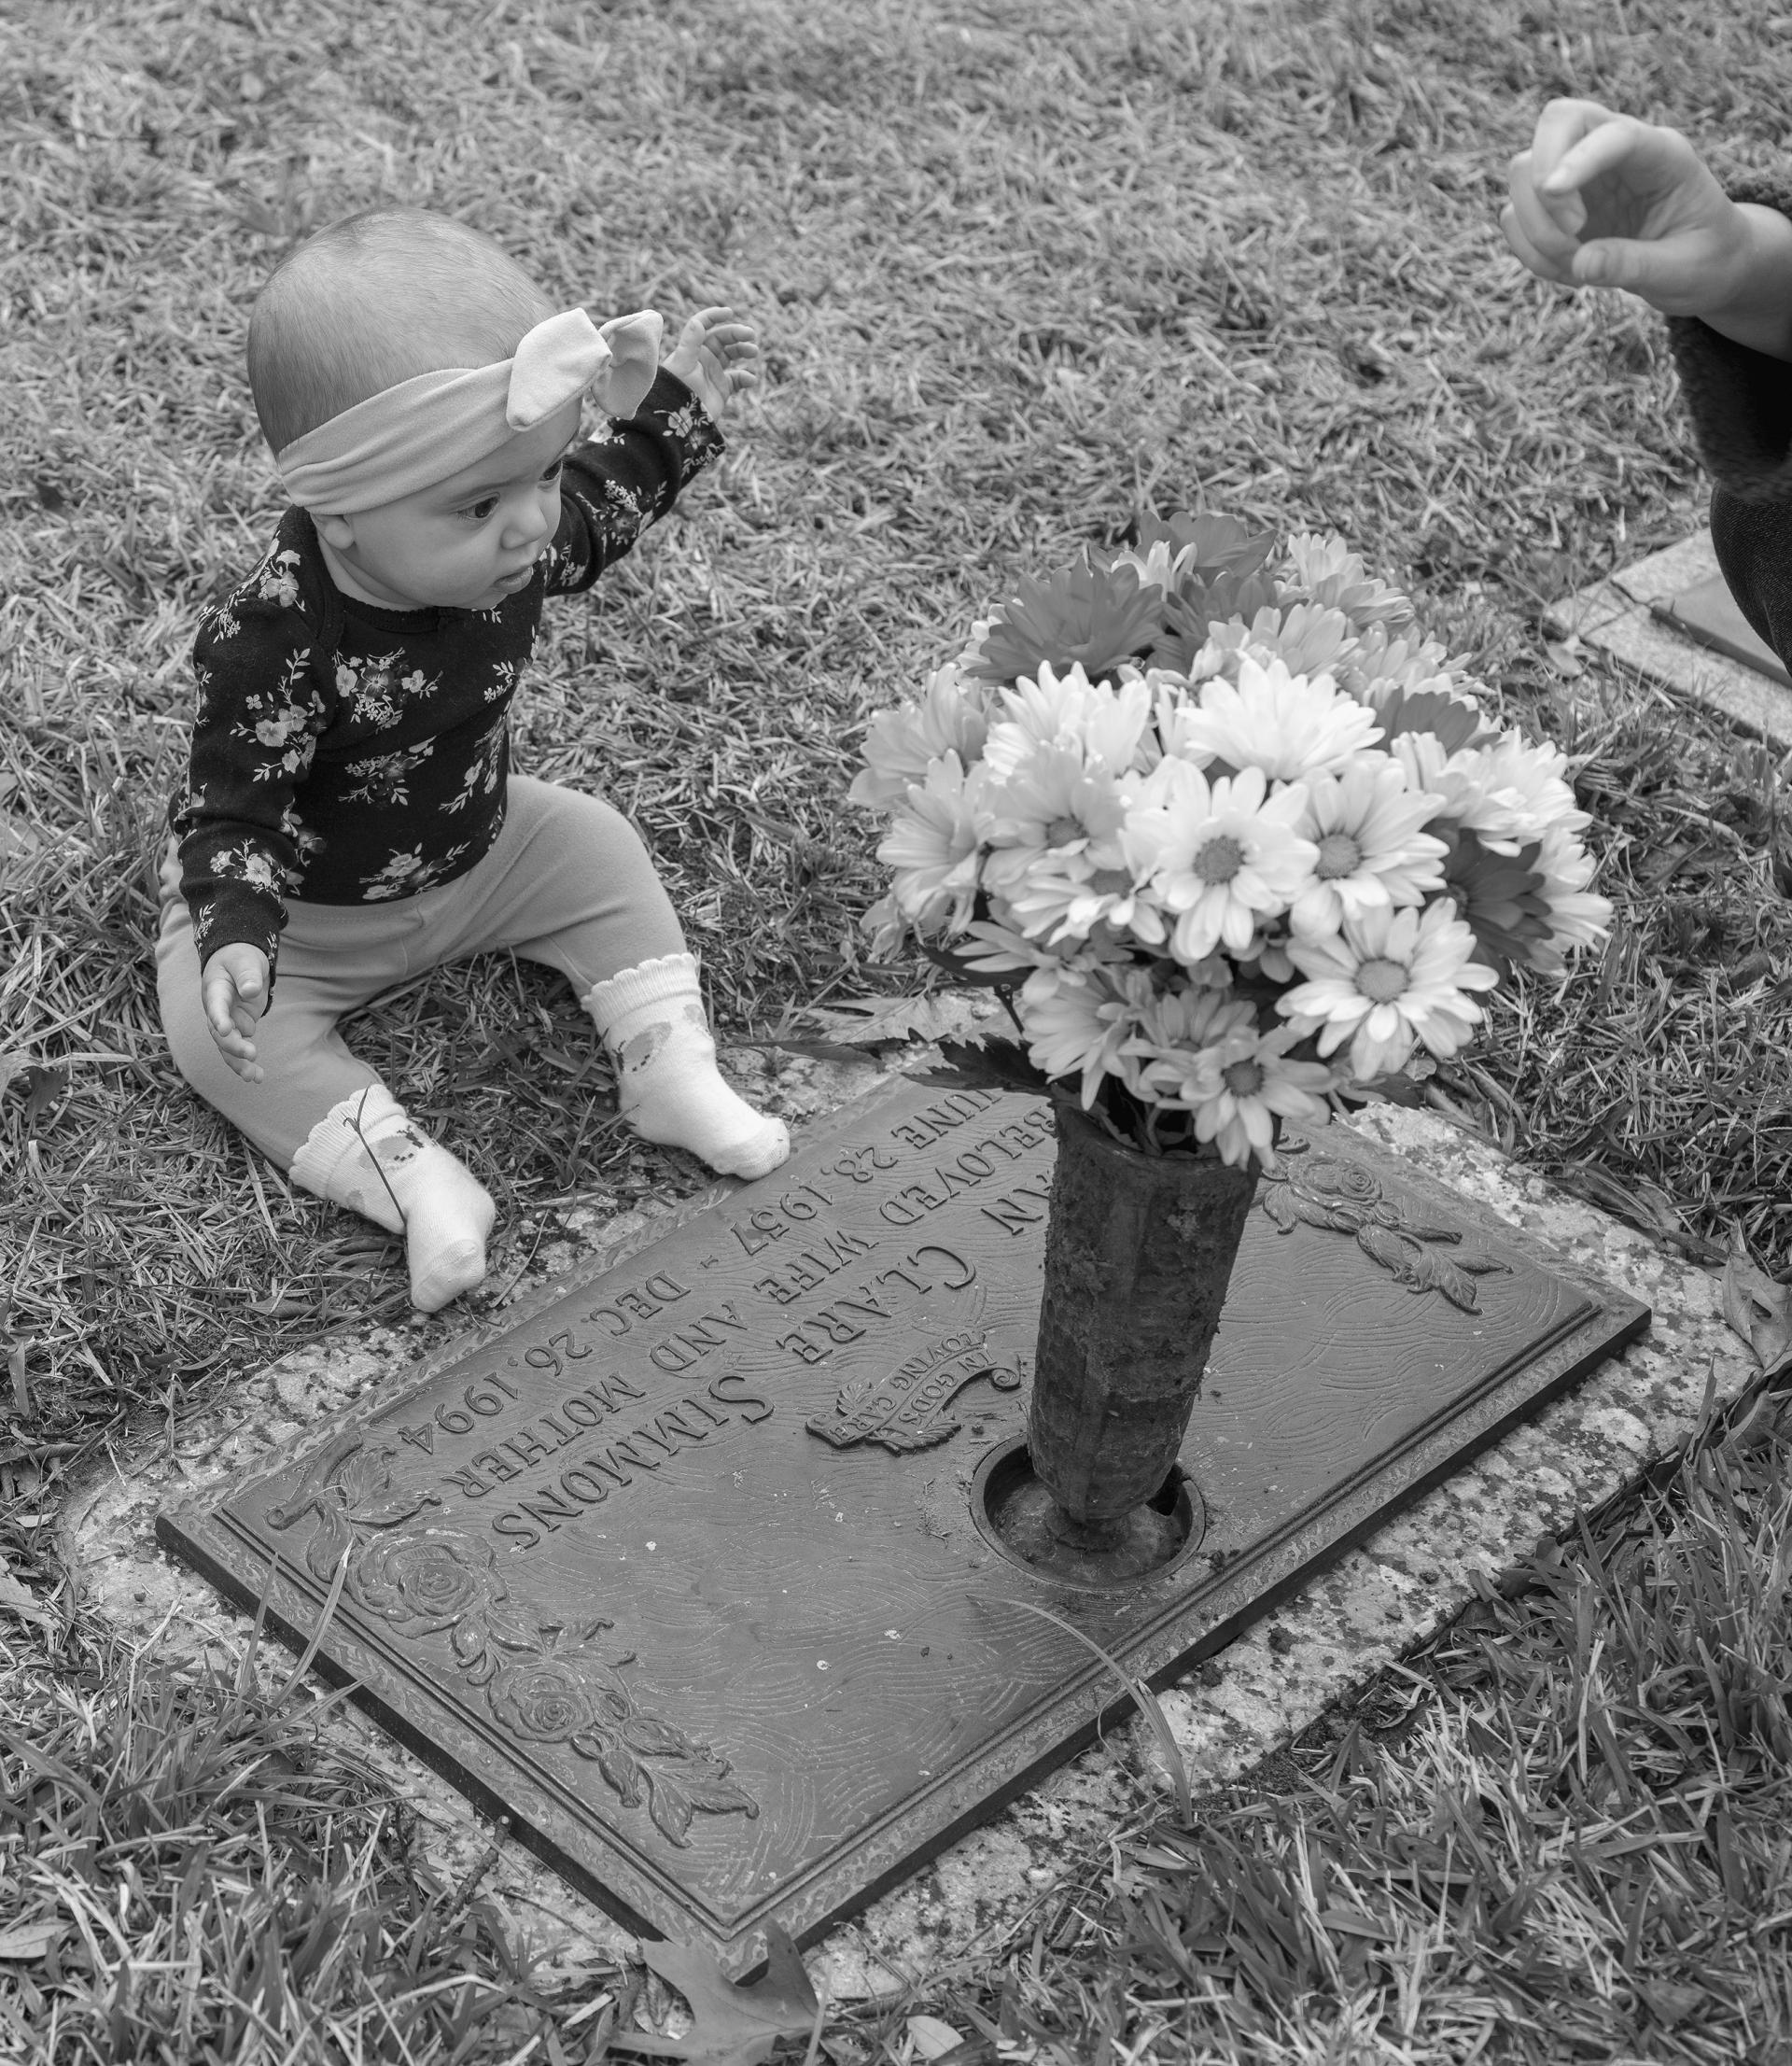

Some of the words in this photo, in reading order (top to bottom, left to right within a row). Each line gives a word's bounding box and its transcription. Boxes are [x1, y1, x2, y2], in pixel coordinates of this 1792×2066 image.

[879, 1105, 1057, 1226] BELOVED
[581, 1270, 692, 1337] DEC.
[752, 1230, 880, 1305] WIFE
[650, 1299, 748, 1372] AND
[776, 1245, 976, 1365] CLARE
[889, 1332, 984, 1390] LOVING
[957, 1351, 997, 1372] IN
[441, 1370, 646, 1497] MOTHER
[829, 1397, 896, 1441] CARE
[491, 1375, 776, 1551] SIMMONS
